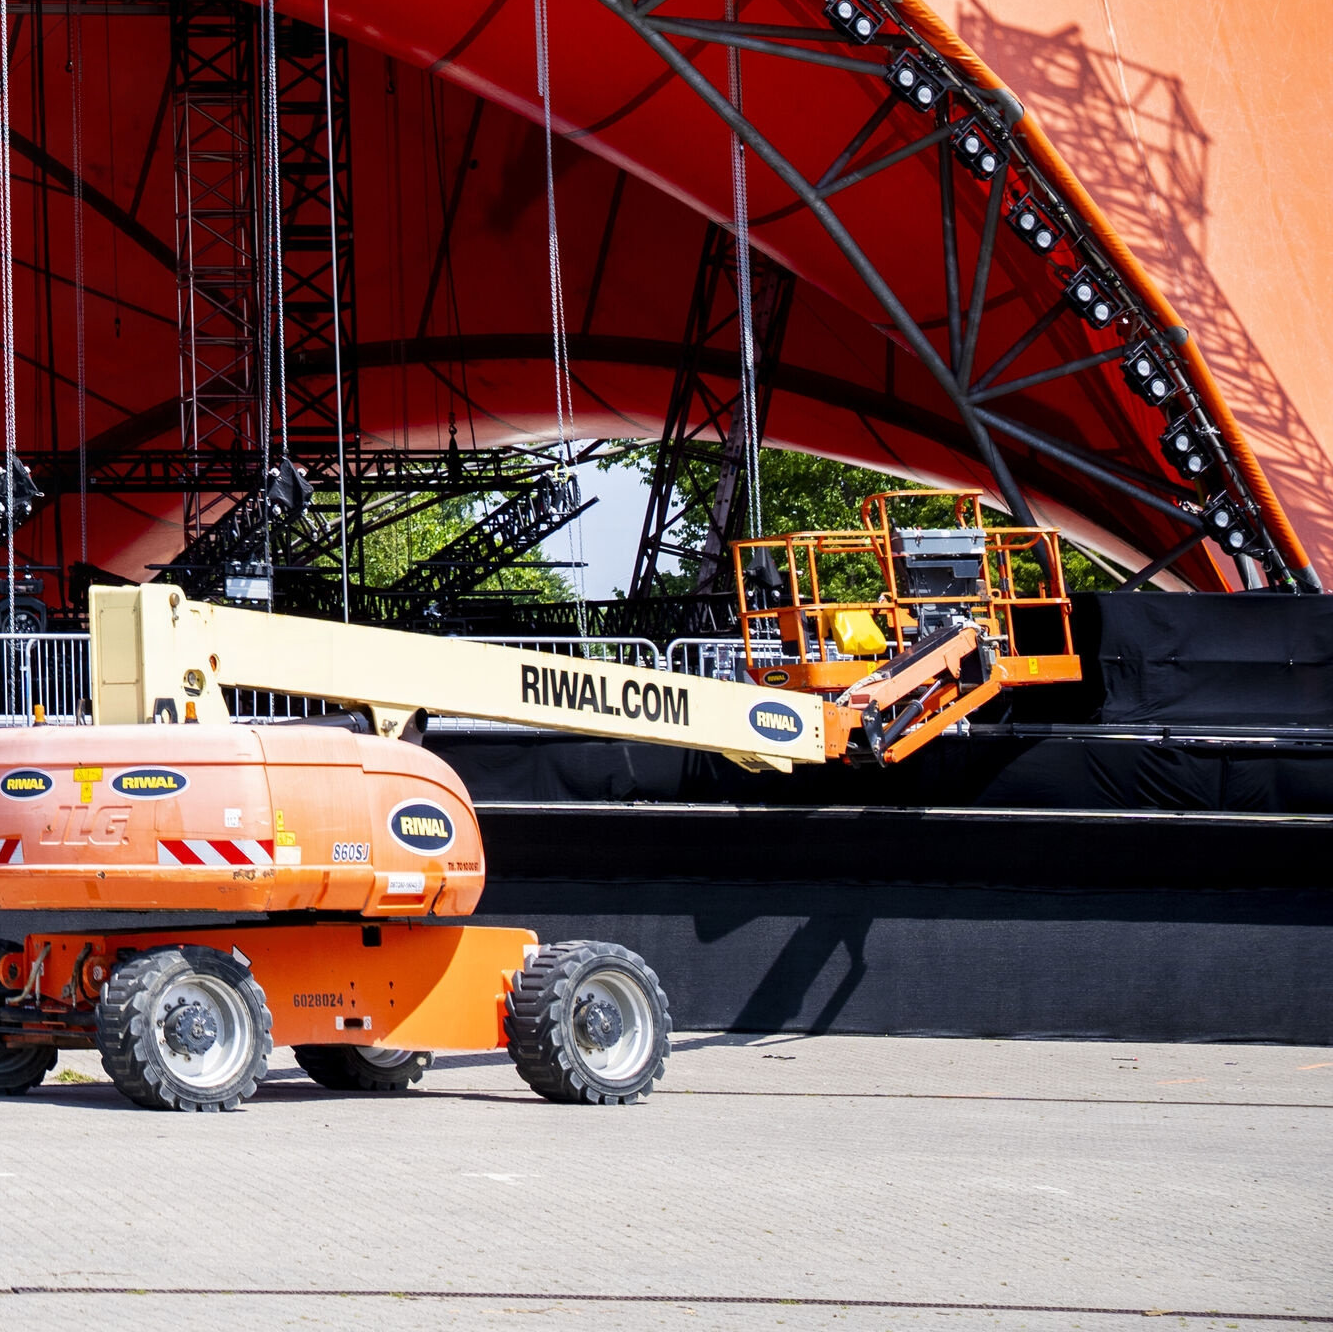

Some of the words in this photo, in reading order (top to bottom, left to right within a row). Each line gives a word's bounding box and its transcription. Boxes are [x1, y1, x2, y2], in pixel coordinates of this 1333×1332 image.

[767, 674, 786, 682] RIWAL
[521, 664, 689, 726] RIWAL.COM
[756, 710, 798, 733] RIWAL
[6, 777, 46, 791] RIWAL
[121, 776, 178, 790] RIWAL
[399, 816, 449, 838] RIWAL
[333, 843, 370, 861] 860SJ
[293, 993, 344, 1007] 6028024
